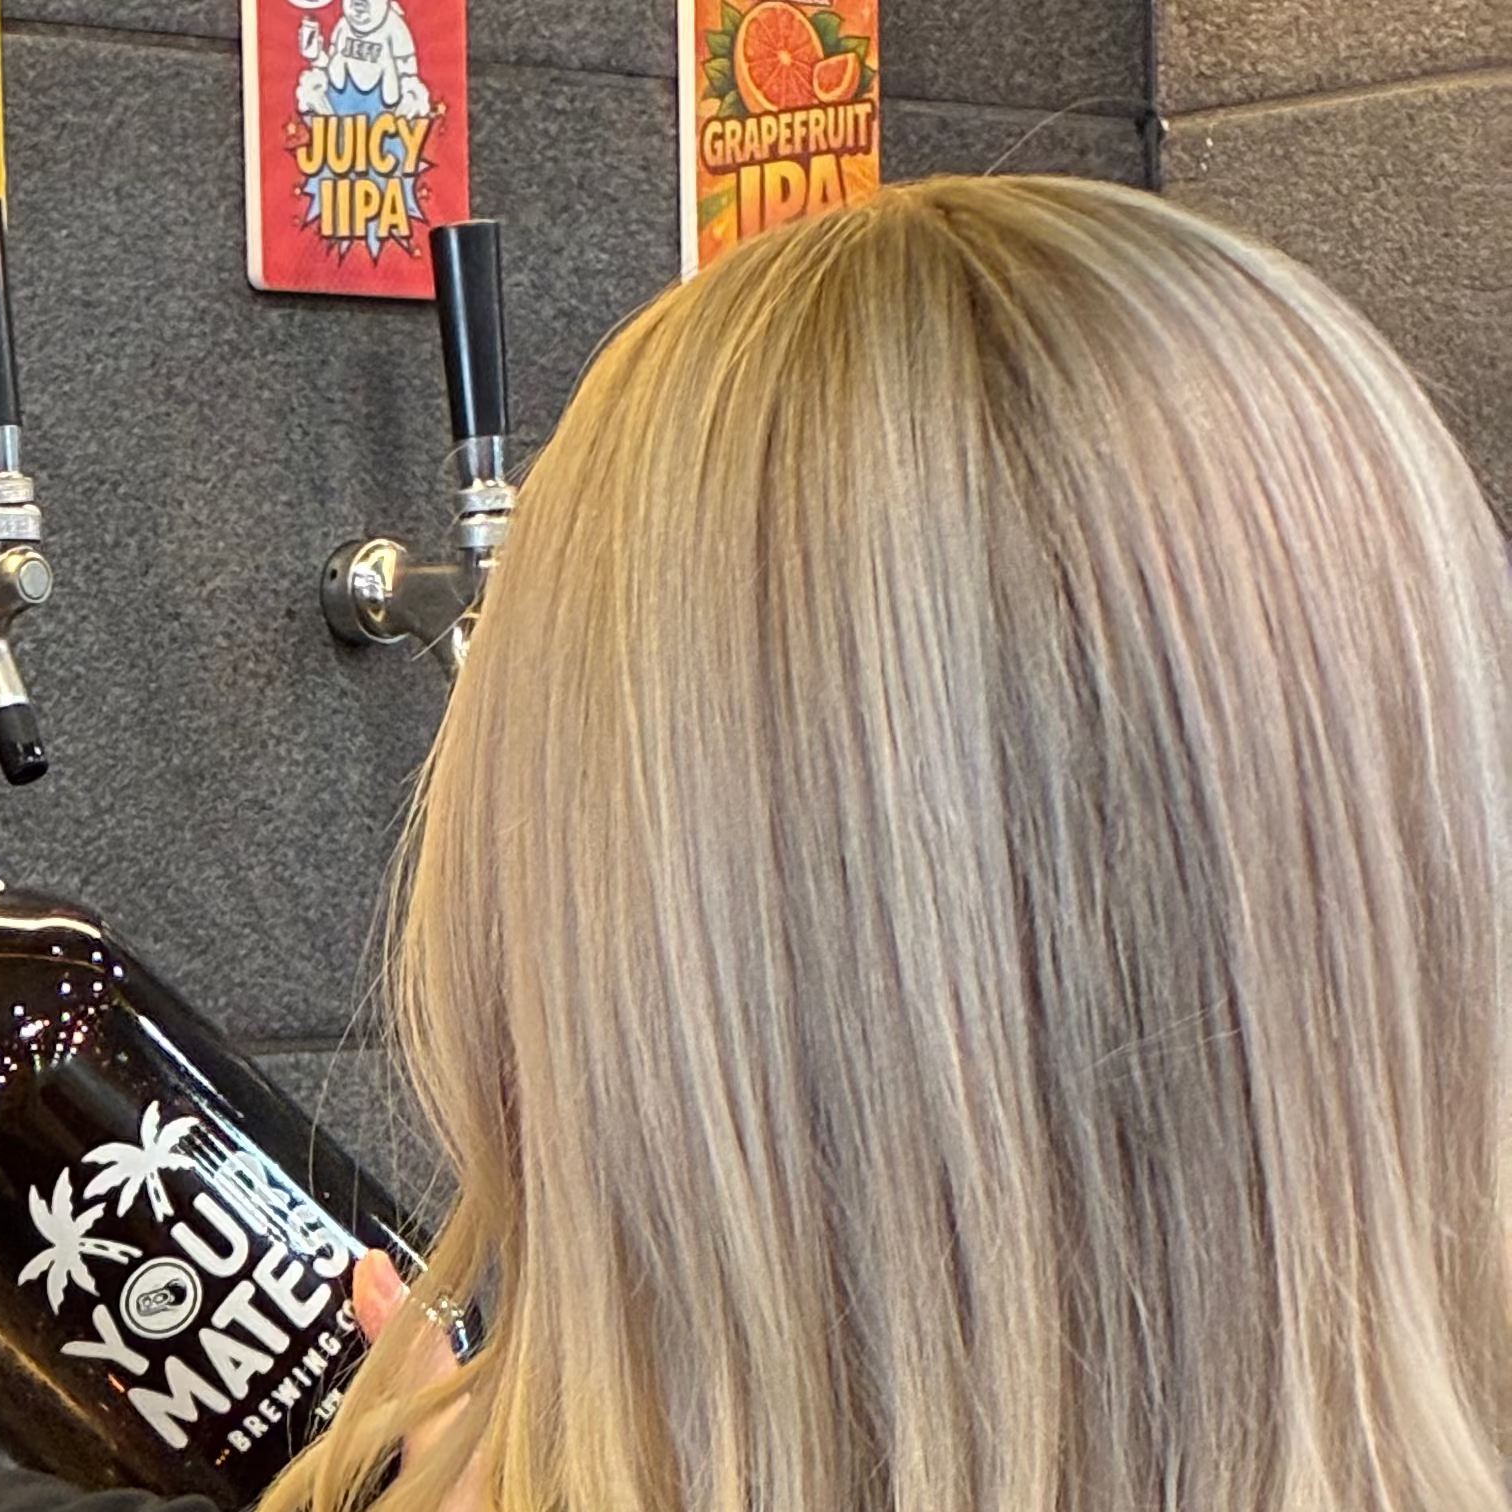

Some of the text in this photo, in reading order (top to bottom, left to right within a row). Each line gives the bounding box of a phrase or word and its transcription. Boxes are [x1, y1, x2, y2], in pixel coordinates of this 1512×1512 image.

[296, 113, 430, 175] JUICY
[703, 103, 872, 168] GRAPEFRUIT
[320, 178, 411, 238] IIPA
[740, 155, 845, 240] IPA
[128, 1204, 350, 1450] MATES
[227, 1331, 342, 1452] BREWING
